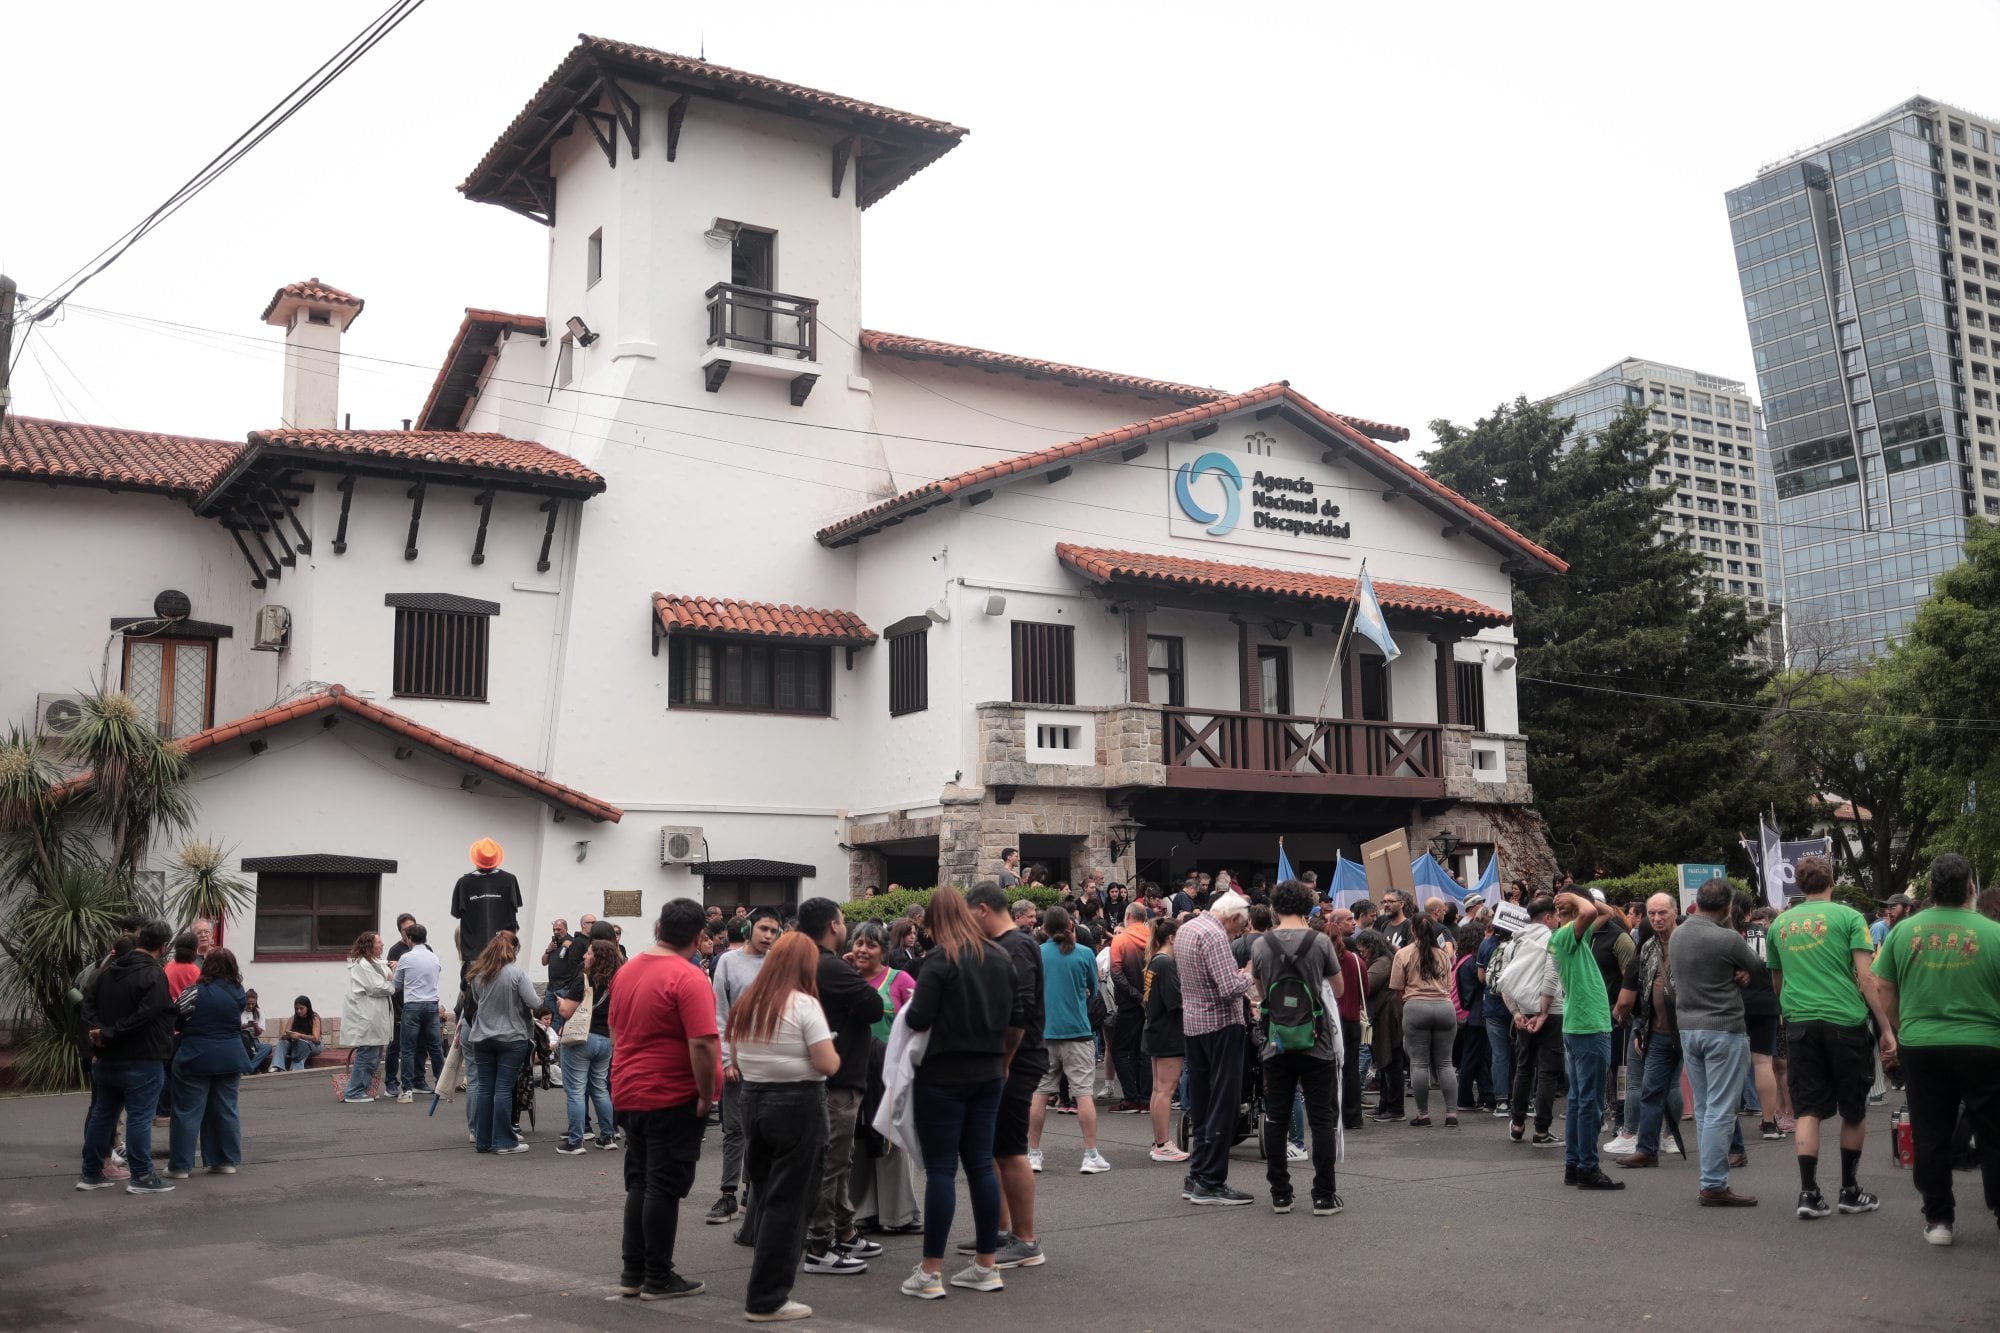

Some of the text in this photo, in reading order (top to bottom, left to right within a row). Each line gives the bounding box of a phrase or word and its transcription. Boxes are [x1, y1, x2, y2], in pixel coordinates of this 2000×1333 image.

[1253, 470, 1313, 494] Agencia
[1253, 491, 1340, 517] Nacional de
[1253, 511, 1350, 538] Discapacidad
